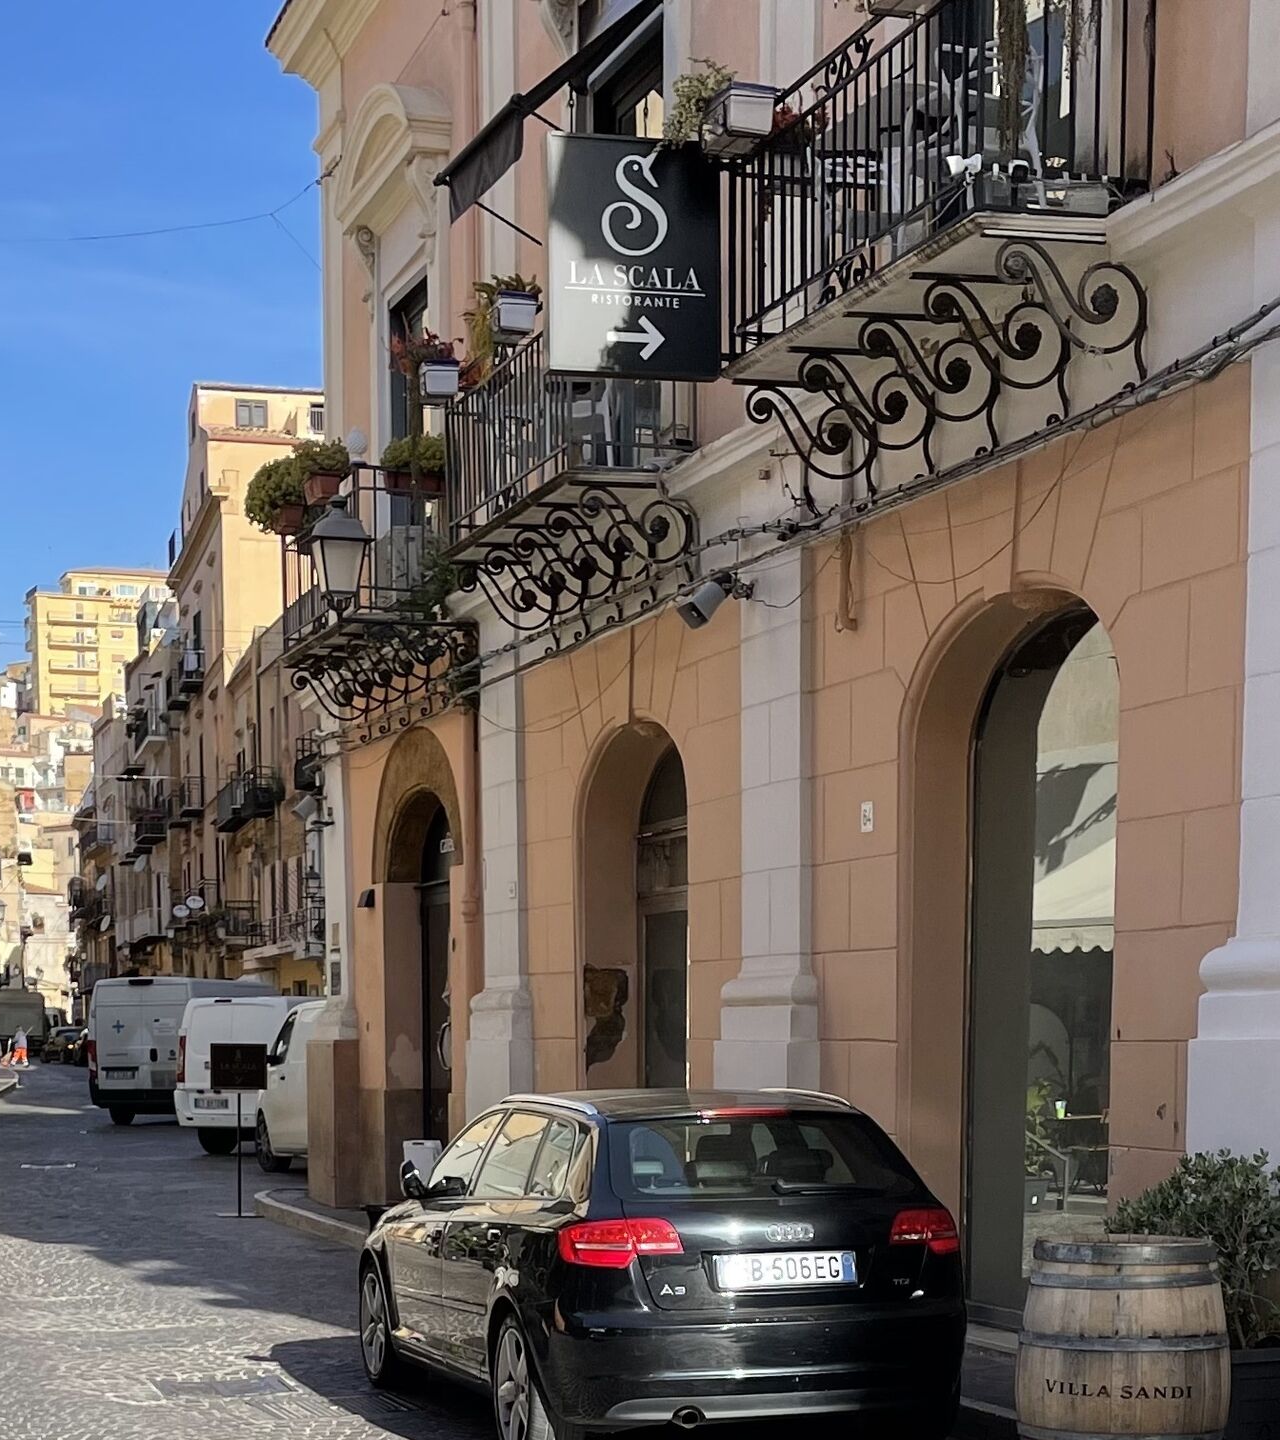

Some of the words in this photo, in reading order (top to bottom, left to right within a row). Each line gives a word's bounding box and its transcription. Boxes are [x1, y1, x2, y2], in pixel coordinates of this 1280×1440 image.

[569, 261, 605, 286] LA
[613, 264, 702, 291] SCALA
[591, 293, 680, 308] RISTORANTE
[771, 1256, 841, 1281] 506EG
[660, 1283, 686, 1296] A3
[1045, 1378, 1112, 1399] VILLA
[1119, 1384, 1193, 1400] SANDI
